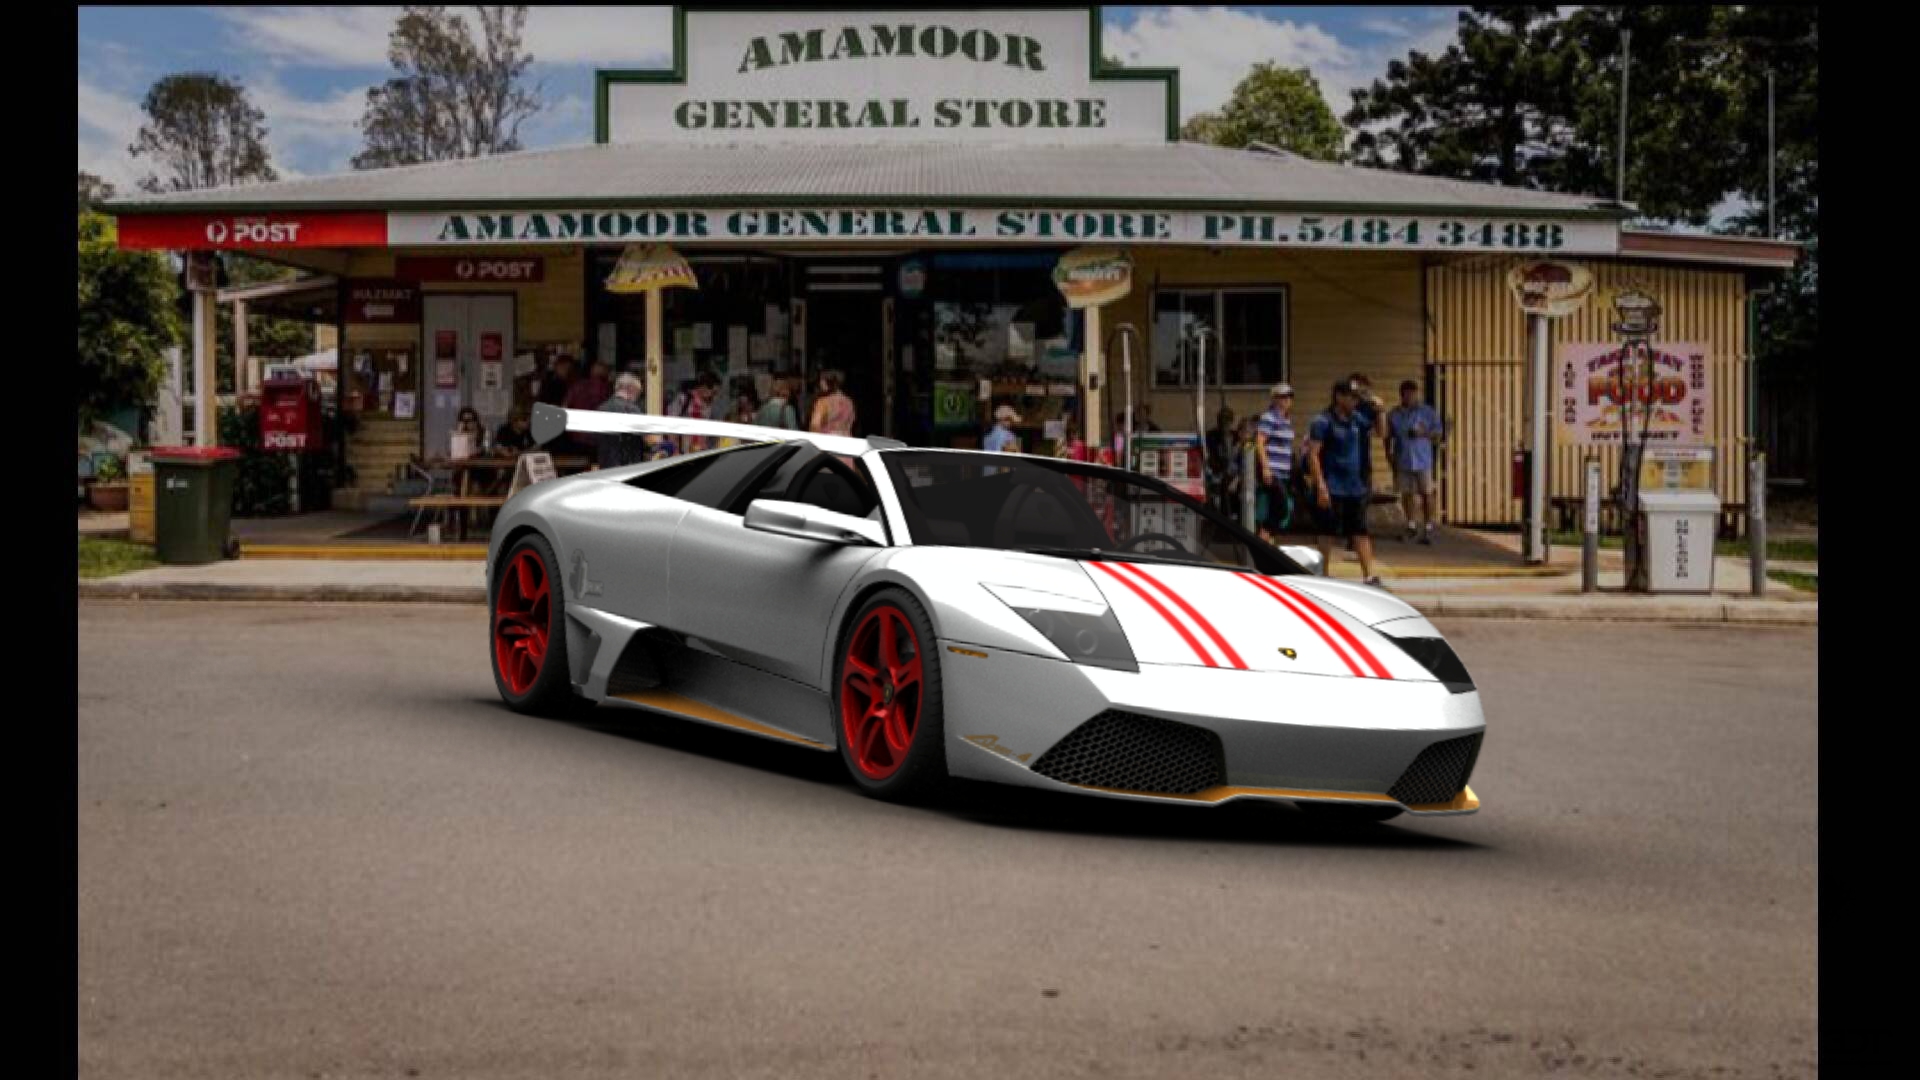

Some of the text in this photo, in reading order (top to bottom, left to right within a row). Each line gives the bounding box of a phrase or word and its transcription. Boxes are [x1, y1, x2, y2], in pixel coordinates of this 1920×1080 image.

[738, 24, 1046, 73] AMAMOOR
[674, 99, 1107, 129] GENERAL STORE
[233, 222, 300, 243] POST
[437, 212, 711, 241] AMAMOOR
[726, 210, 976, 237] GENERAL
[996, 211, 1172, 240] STORE
[1434, 221, 1564, 249] 3488
[479, 261, 535, 278] POST
[264, 431, 306, 448] POST
